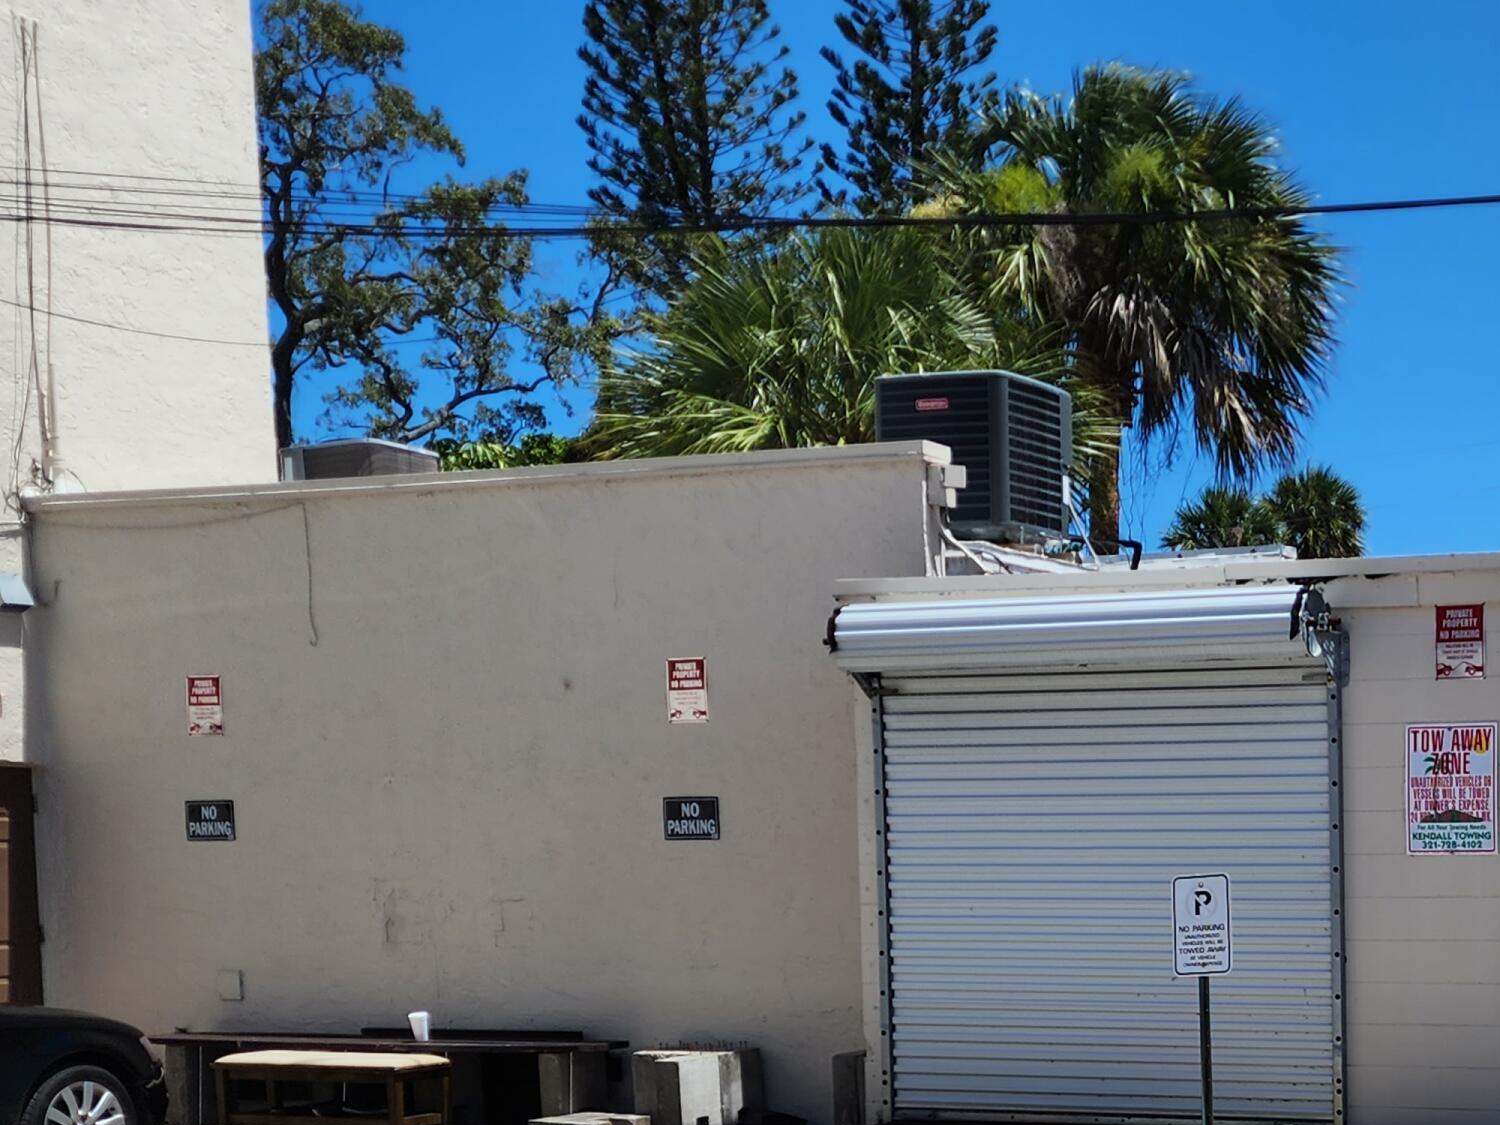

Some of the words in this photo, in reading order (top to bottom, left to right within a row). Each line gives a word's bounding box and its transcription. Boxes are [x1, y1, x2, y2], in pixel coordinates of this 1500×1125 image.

[1446, 609, 1472, 618] PRIVATE
[1442, 618, 1478, 628] PROPERTY
[1440, 630, 1450, 639] NO
[1452, 629, 1480, 638] PARKING
[1411, 730, 1444, 752] TOW
[1451, 728, 1492, 752] AWAY
[1431, 752, 1470, 774] ZONE
[1411, 776, 1453, 787] UNAUTHORIZED
[1455, 776, 1482, 786] VEHICLES
[1484, 776, 1492, 786] OR
[1413, 788, 1440, 799] VESSELS
[1442, 788, 1456, 799] WILL
[1459, 788, 1466, 799] BE
[1469, 788, 1490, 798] TOWED
[681, 802, 700, 817] NO
[1414, 800, 1421, 810] AT
[1425, 800, 1456, 810] OWNER'S
[1459, 800, 1488, 810] EXPENSE
[201, 805, 217, 820] NO
[190, 821, 231, 836] PARKING
[668, 818, 716, 834] PARKING
[1412, 832, 1452, 840] KENDALL
[1455, 832, 1491, 840] TOWING
[1192, 923, 1224, 932] PARKING
